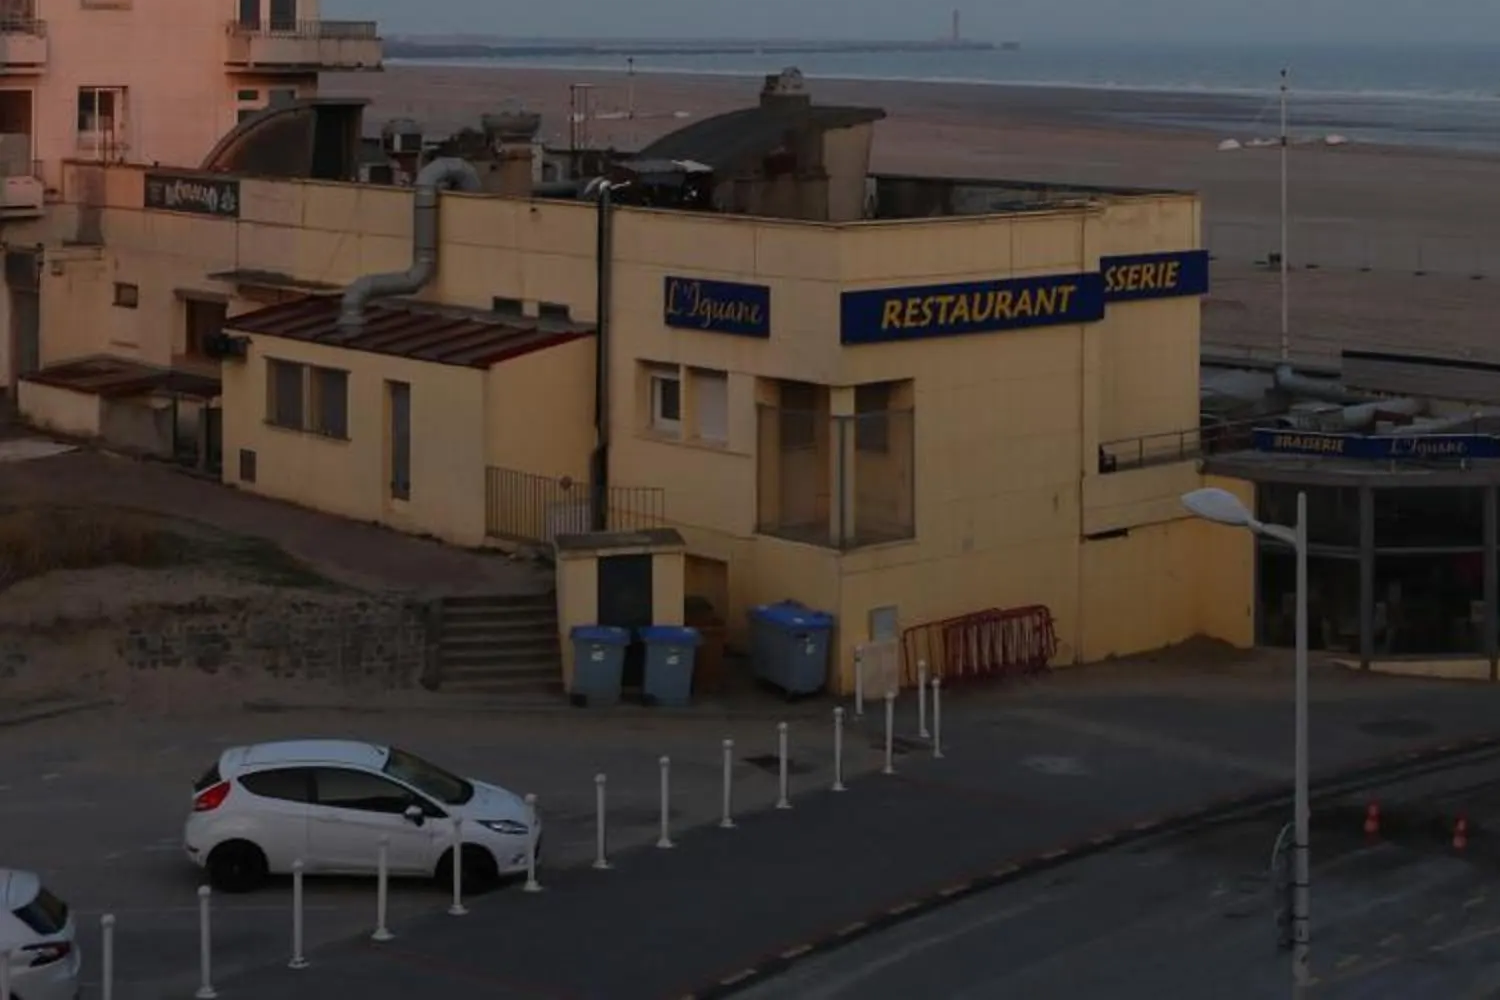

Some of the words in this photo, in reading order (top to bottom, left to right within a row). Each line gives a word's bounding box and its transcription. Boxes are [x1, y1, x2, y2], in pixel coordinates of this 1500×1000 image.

[1103, 261, 1180, 293] SSERIE
[668, 280, 763, 328] L'Iguane
[881, 284, 1077, 331] RESTAURANT
[1273, 434, 1344, 452] BRASSERIE
